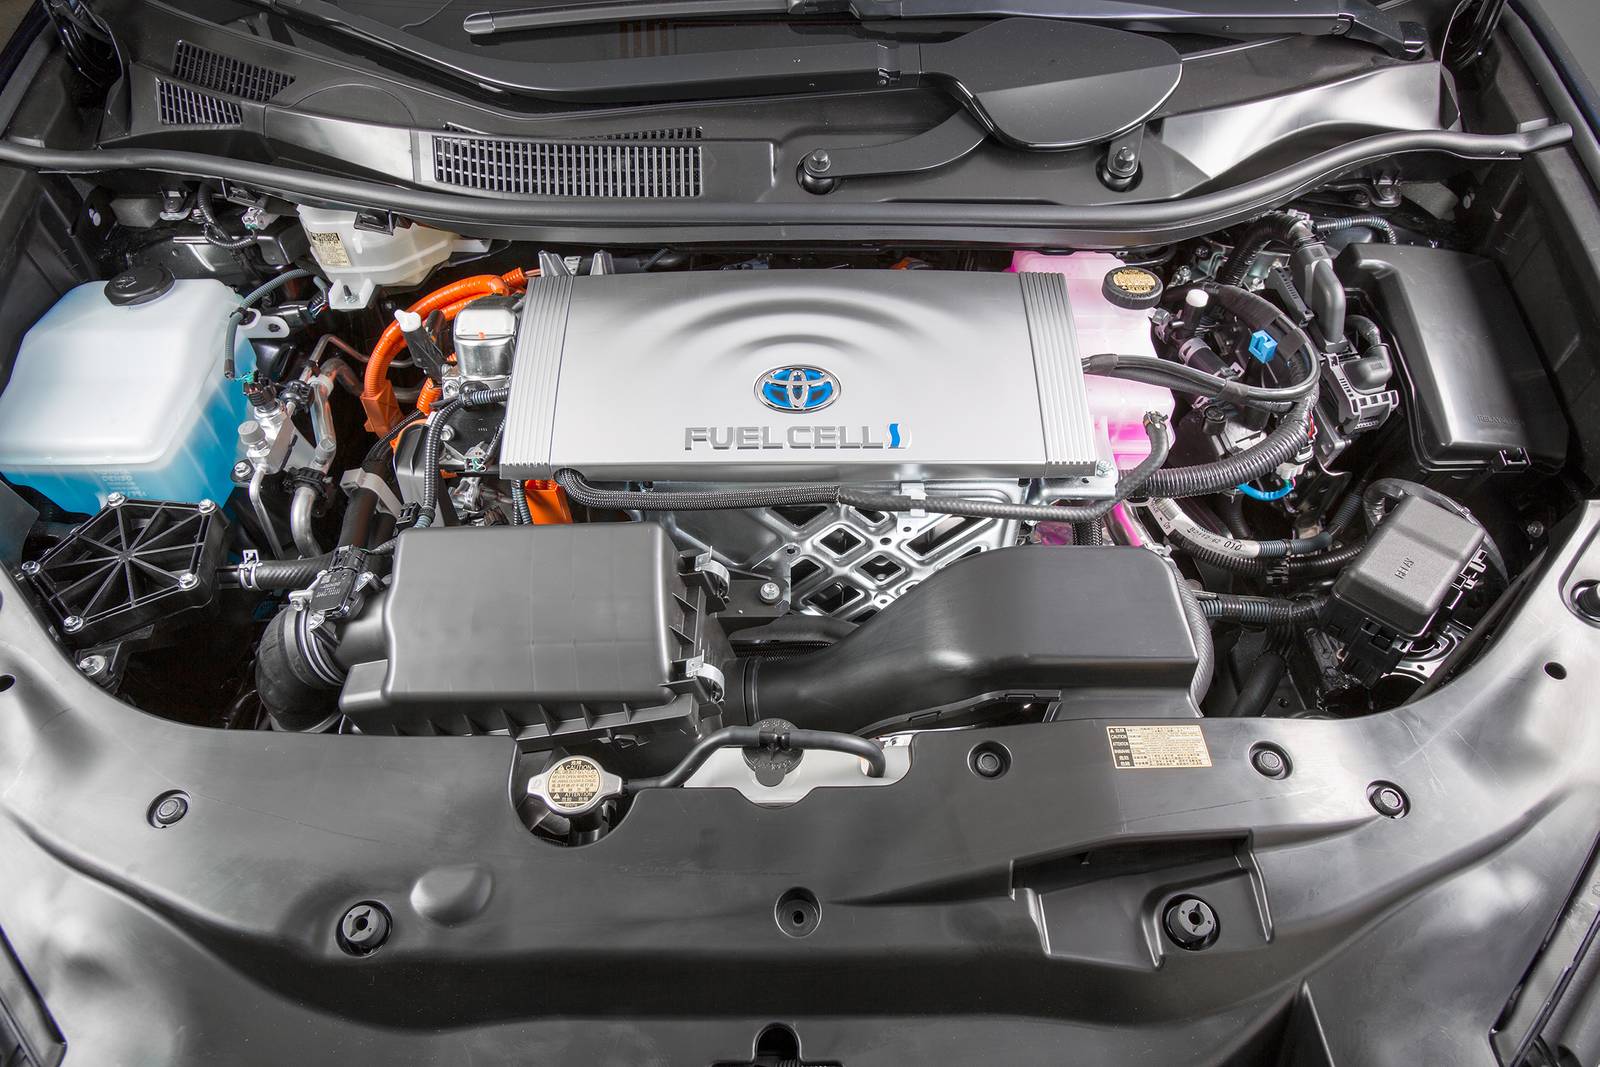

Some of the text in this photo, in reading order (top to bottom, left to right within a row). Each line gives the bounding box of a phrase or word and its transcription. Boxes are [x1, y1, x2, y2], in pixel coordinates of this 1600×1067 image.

[684, 425, 884, 450] FUEL CELL
[1223, 540, 1243, 551] 010
